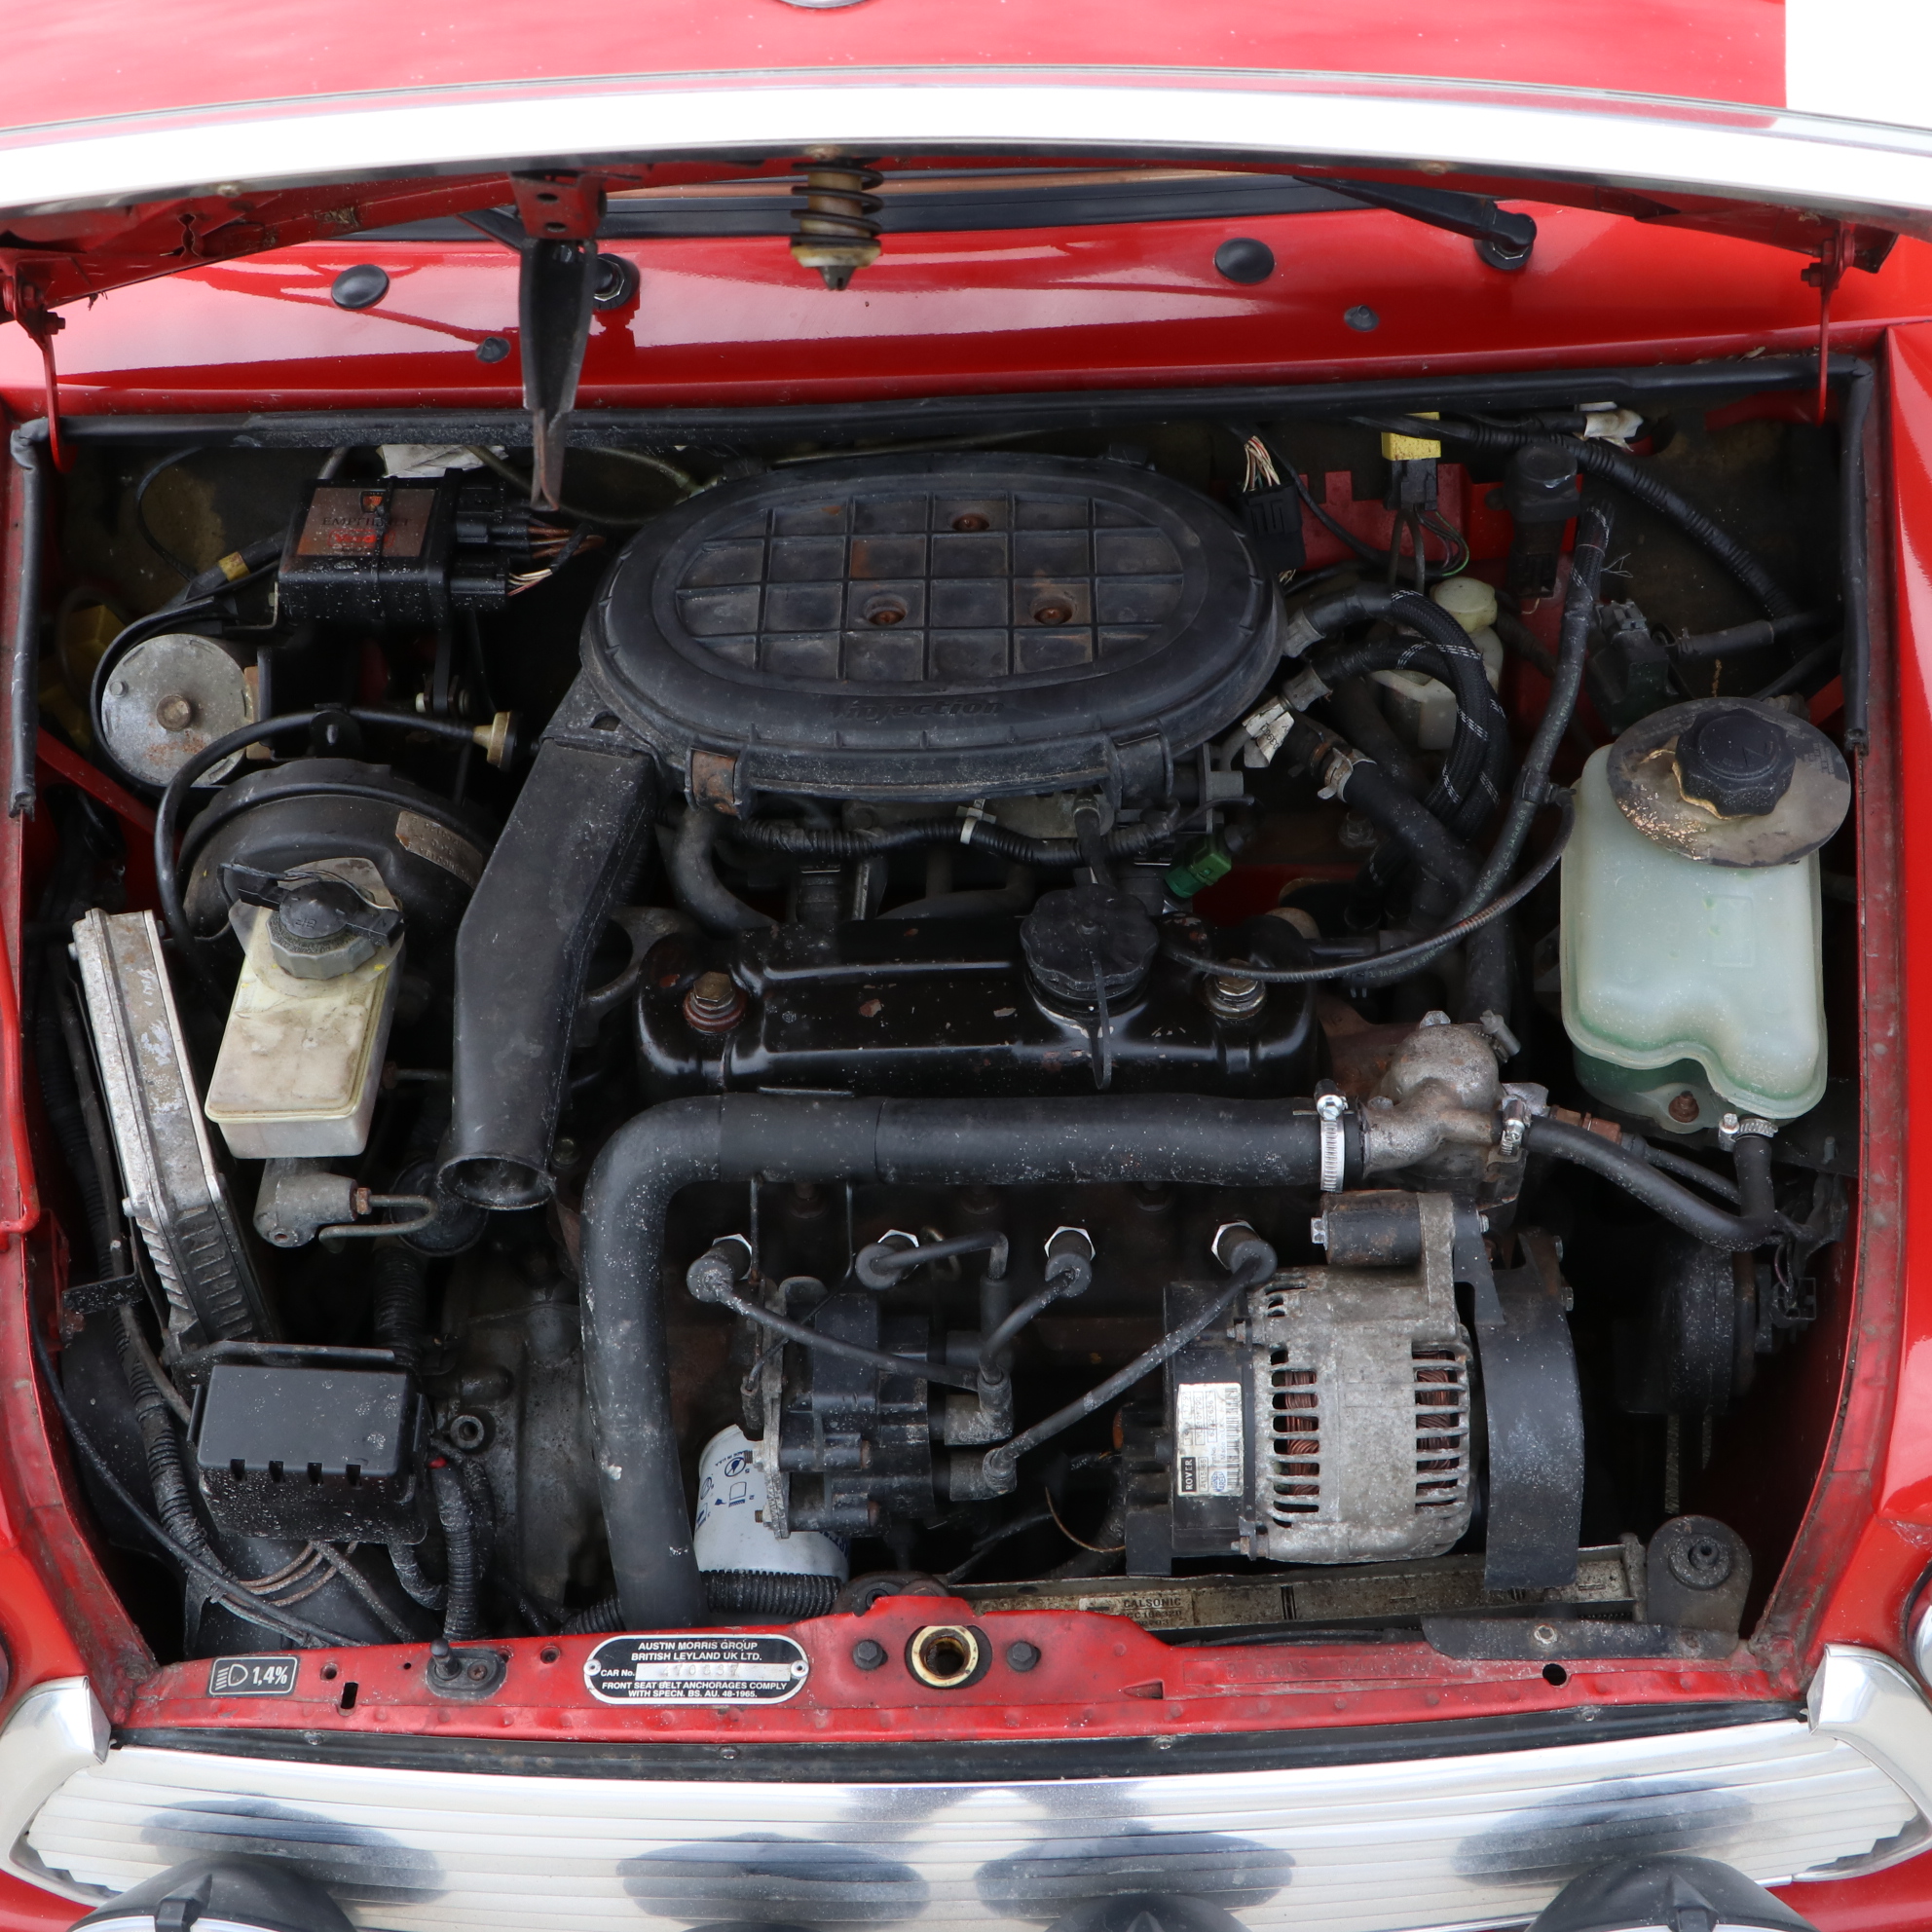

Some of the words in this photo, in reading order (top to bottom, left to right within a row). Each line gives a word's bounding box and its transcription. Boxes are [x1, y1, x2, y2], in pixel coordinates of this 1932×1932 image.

[845, 699, 1004, 723] injection
[1184, 1459, 1194, 1491] ROVER
[1124, 1598, 1181, 1608] CALSONIC
[638, 1642, 675, 1651] AUSTIN
[678, 1642, 718, 1651] MORRIS
[631, 1653, 671, 1661] BRITISH
[252, 1665, 289, 1686] 1,4%
